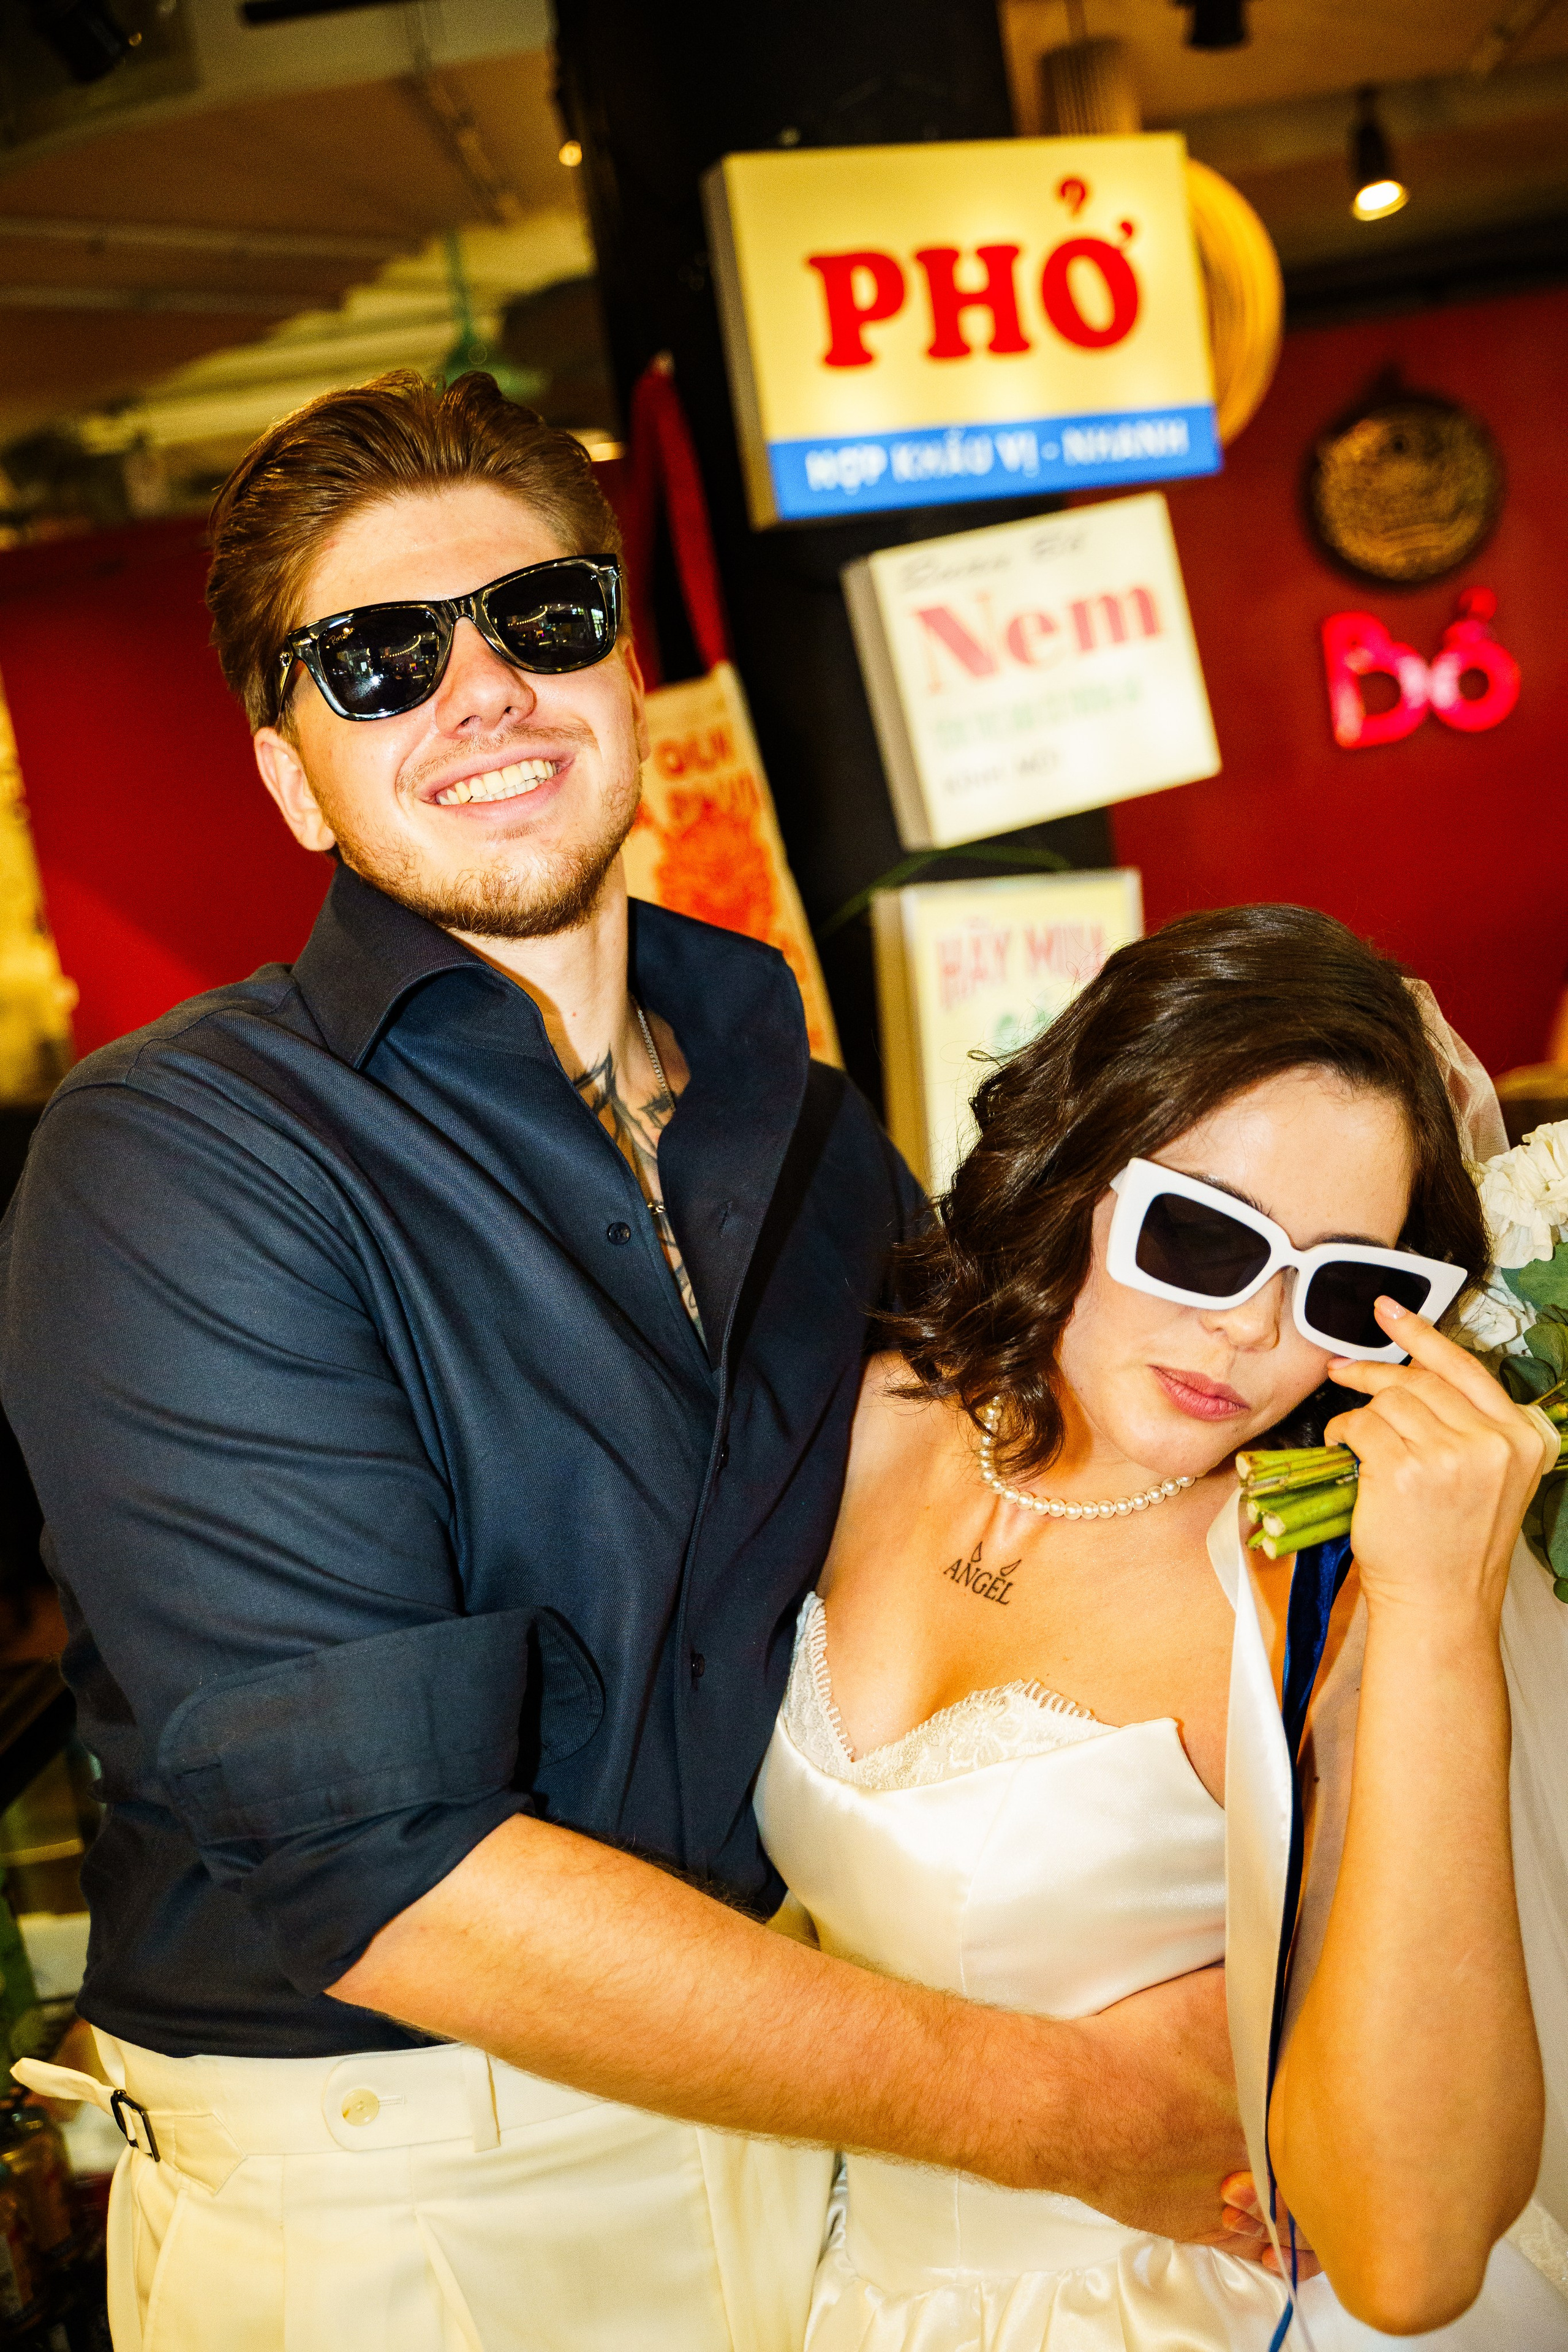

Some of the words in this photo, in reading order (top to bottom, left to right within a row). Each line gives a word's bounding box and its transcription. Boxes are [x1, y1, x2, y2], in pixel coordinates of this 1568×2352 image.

[809, 176, 1140, 369] PHỞ
[1062, 420, 1189, 467] NHANH
[911, 582, 1166, 695] Nem
[943, 1558, 1014, 1605] ANGEL
